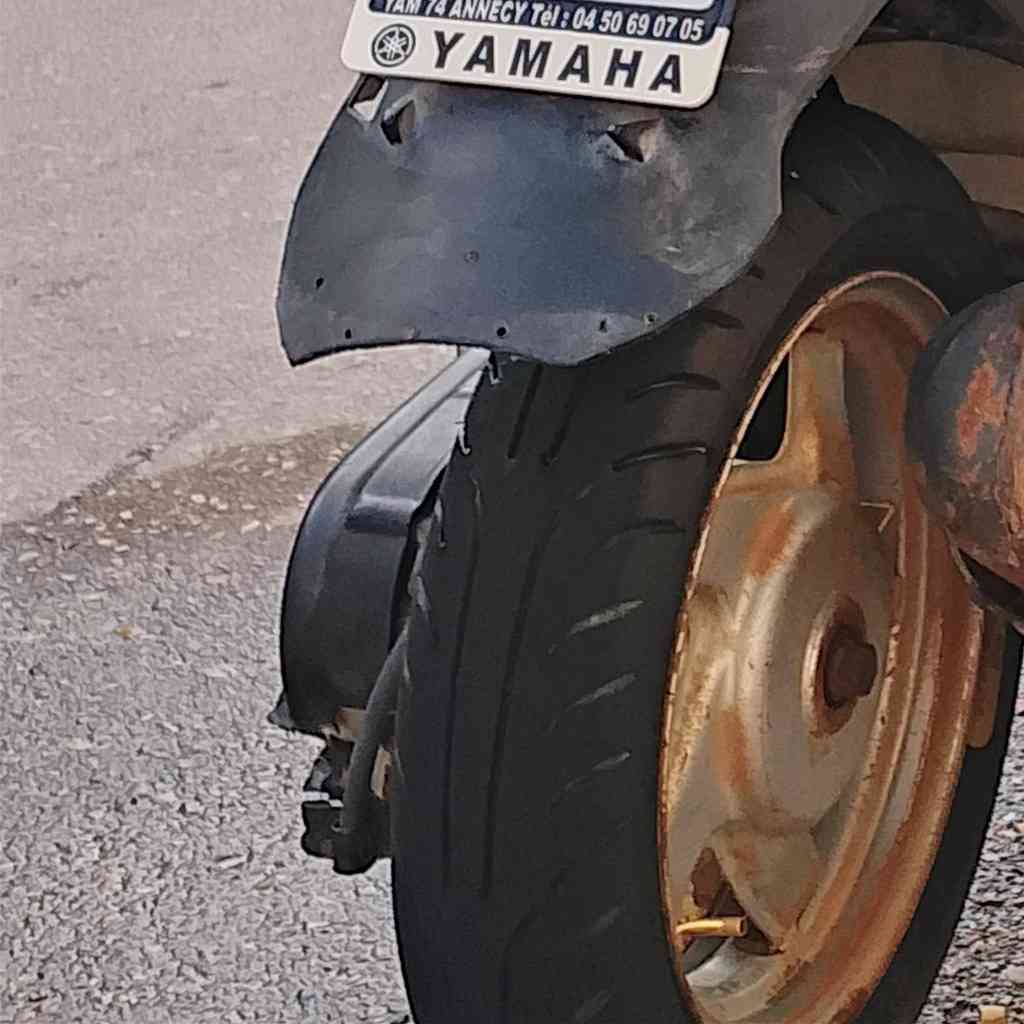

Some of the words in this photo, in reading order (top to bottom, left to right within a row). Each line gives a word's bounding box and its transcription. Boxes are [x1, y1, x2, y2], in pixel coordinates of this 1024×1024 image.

[572, 6, 598, 31] 04
[599, 9, 623, 34] 50
[625, 12, 651, 37] 69
[652, 15, 679, 39] 07
[679, 17, 705, 42] 05
[433, 29, 682, 94] YAMAHA
